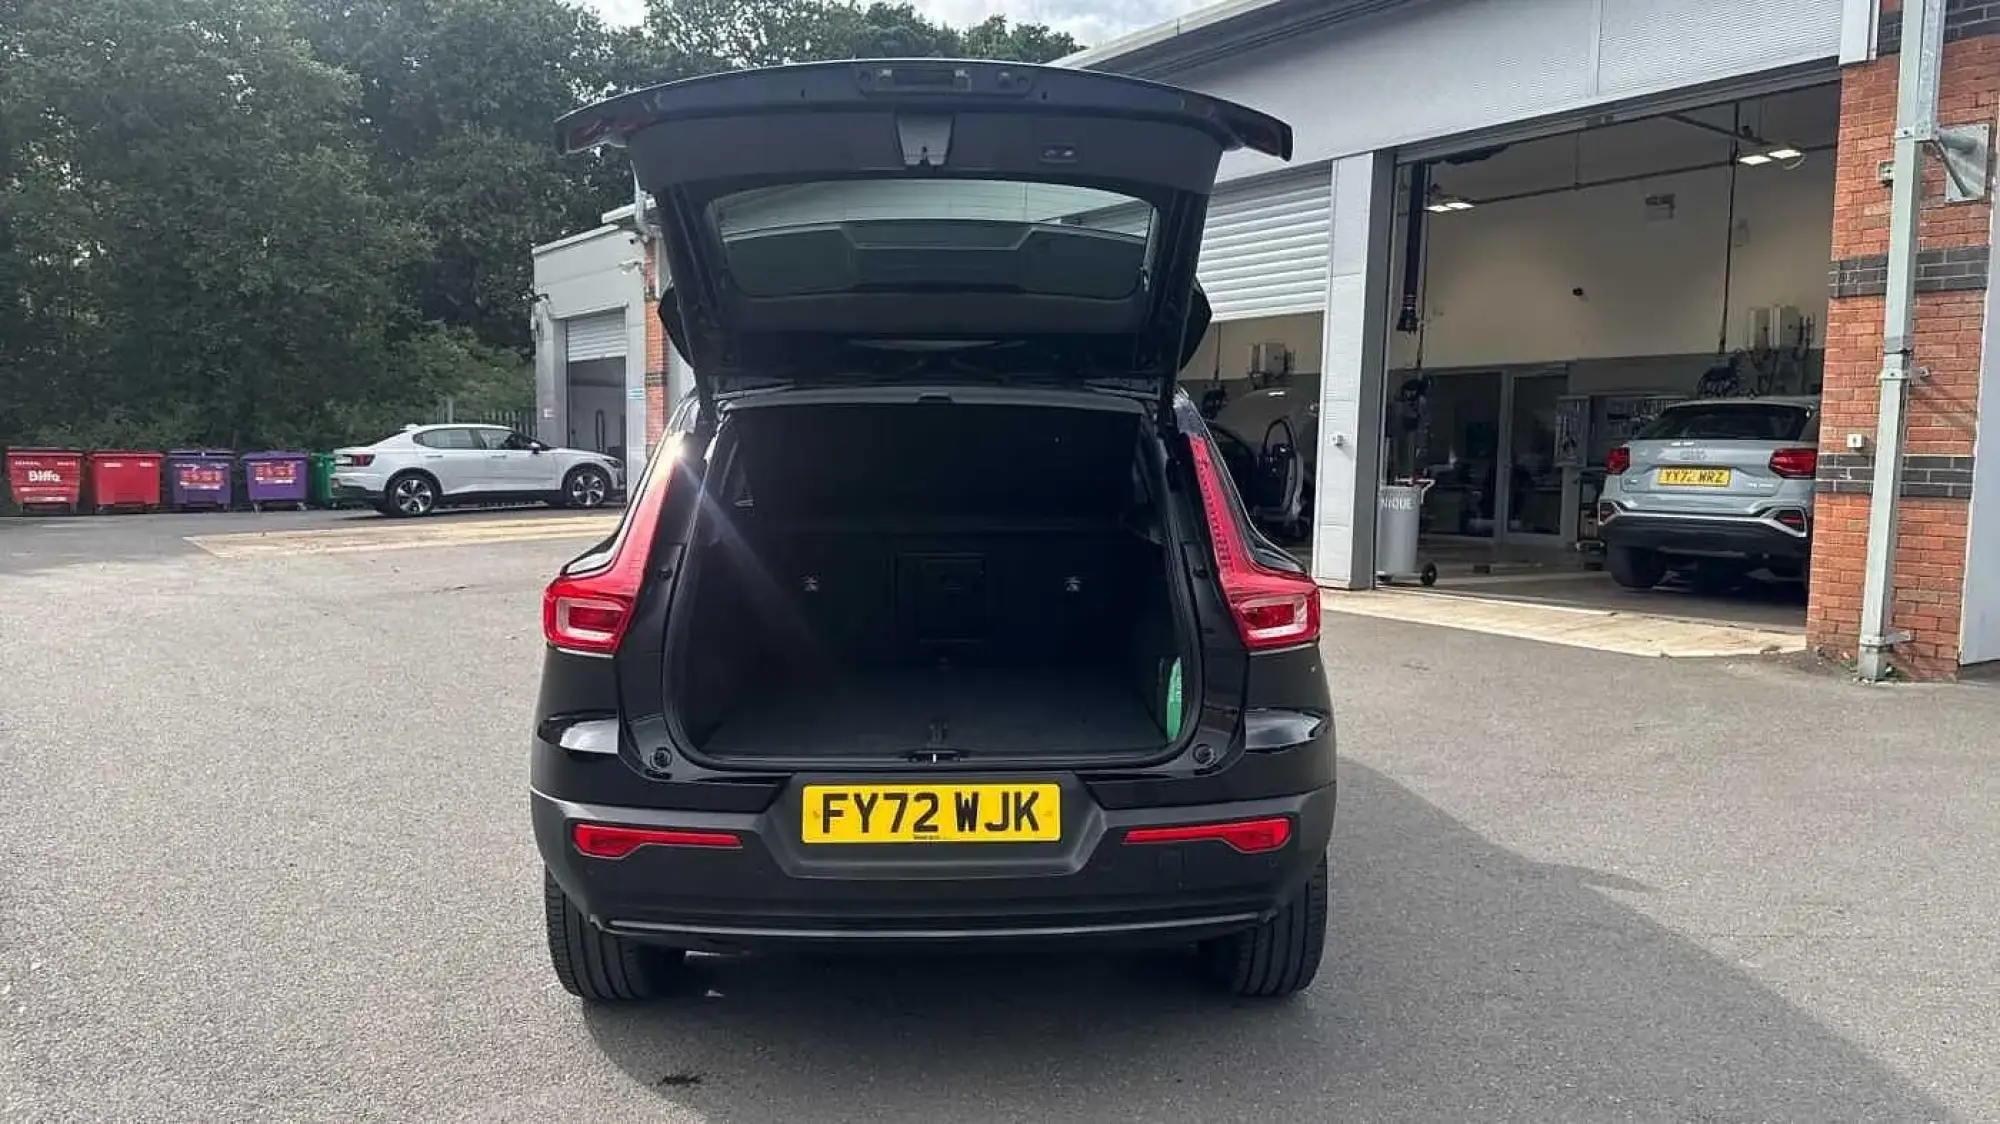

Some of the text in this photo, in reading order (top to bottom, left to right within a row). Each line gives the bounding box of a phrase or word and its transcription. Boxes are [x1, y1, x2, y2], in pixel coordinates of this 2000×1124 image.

[28, 470, 61, 482] Biffa
[1665, 470, 1725, 483] YY72 WRZ
[822, 791, 1040, 833] FY72 WJK
